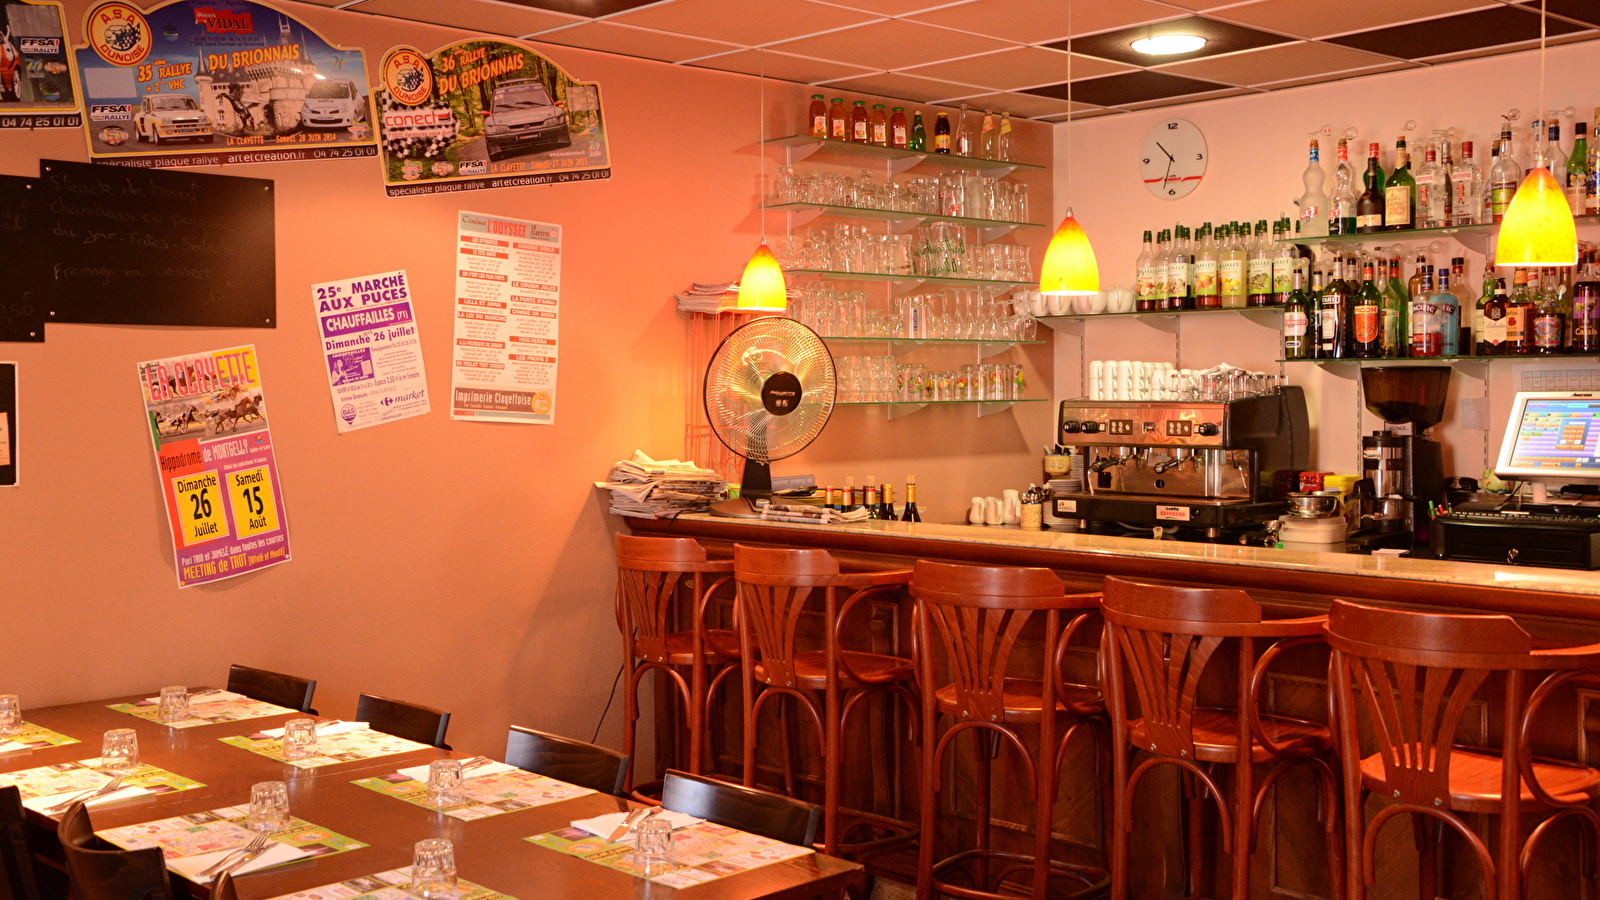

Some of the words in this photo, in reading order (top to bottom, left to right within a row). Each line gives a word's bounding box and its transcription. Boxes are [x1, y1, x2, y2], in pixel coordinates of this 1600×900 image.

[206, 18, 251, 30] VIDAL
[100, 44, 145, 62] DUNOISE
[207, 53, 228, 71] DU
[231, 44, 300, 68] BRIONNAIS
[460, 46, 487, 67] RALLYE
[158, 62, 192, 79] RALLYE
[438, 74, 458, 96] DU
[460, 53, 524, 89] BRIONNAIS
[168, 78, 185, 90] VHC
[394, 86, 427, 100] DUNOISE
[91, 105, 127, 113] FFSA
[2, 118, 16, 126] 04
[20, 118, 32, 126] 74
[36, 118, 50, 126] 25
[53, 117, 65, 126] 01
[68, 116, 78, 126] 01
[385, 111, 437, 126] conect
[1168, 122, 1178, 130] 12
[226, 137, 234, 146] LA
[236, 136, 264, 144] CLAYETTE
[276, 134, 296, 144] Samedi
[298, 134, 306, 142] 28
[308, 134, 322, 142] JUIN
[323, 133, 336, 142] 2014
[155, 158, 190, 168] plaque
[192, 156, 218, 166] rallye
[313, 150, 326, 158] 04
[330, 149, 339, 158] 74
[342, 148, 352, 157] 25
[354, 148, 364, 156] 01
[366, 146, 376, 156] 01
[490, 164, 498, 172] LA
[500, 162, 526, 172] CLAYETTE
[50, 175, 114, 196] Steack
[122, 178, 146, 197] de
[390, 184, 432, 196] spécialiste
[434, 184, 462, 193] plaque
[464, 182, 484, 190] rallye
[558, 174, 570, 182] 04
[581, 172, 590, 180] 25
[601, 170, 609, 178] 01
[1301, 206, 1317, 220] GET
[53, 221, 78, 238] du
[462, 215, 486, 226] Cinéma
[487, 219, 528, 238] L'ODYSSÉE
[54, 262, 116, 286] Fromage
[352, 272, 405, 294] MARCHÉ
[320, 296, 354, 313] AUX
[361, 287, 408, 306] PUCES
[326, 308, 394, 332] CHAUFFAILLES
[326, 335, 370, 351] Dimanche
[374, 332, 386, 342] 26
[388, 326, 415, 342] juillet
[1575, 328, 1598, 336] Cassis
[146, 364, 172, 401] LA
[174, 350, 255, 397] CLAYETTE
[394, 389, 425, 403] market
[455, 390, 492, 404] Imprimerie
[495, 392, 531, 406] Clayettoise
[160, 451, 202, 472] Hippodrome
[202, 447, 212, 463] de
[212, 438, 248, 461] MONTGELLY
[178, 474, 216, 493] Dimanche
[235, 468, 264, 486] Samedi
[190, 488, 212, 520] 26
[242, 486, 264, 516] 15
[194, 522, 218, 538] Juillet
[250, 516, 267, 530] Août
[182, 556, 192, 566] Pari
[193, 554, 204, 564] TRIO
[204, 552, 210, 560] et
[211, 545, 229, 560] JUMELÉ
[230, 544, 242, 554] dans
[242, 540, 258, 552] toutes
[266, 534, 284, 546] courses
[184, 560, 216, 580] MEETING
[218, 559, 228, 572] de
[229, 552, 247, 570] TROT
